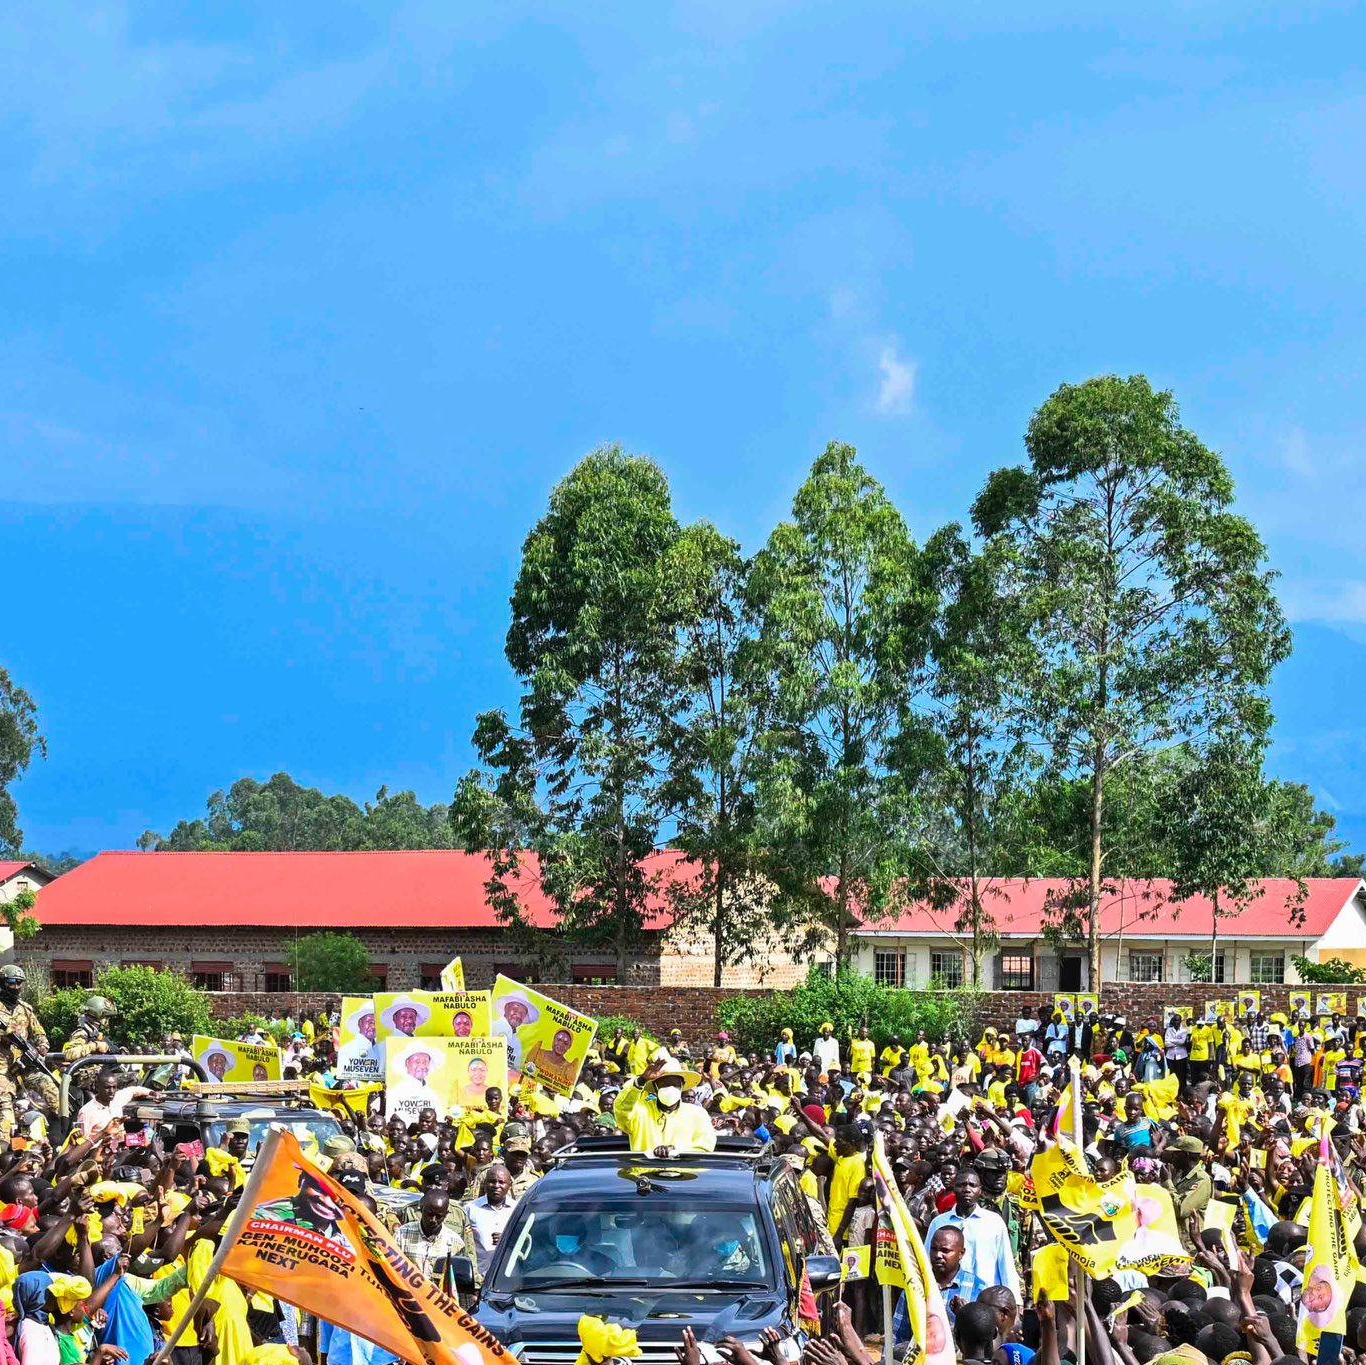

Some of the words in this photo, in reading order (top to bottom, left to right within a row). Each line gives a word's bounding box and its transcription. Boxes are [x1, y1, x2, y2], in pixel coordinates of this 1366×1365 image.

[545, 1004, 573, 1021] MAFABI
[571, 1018, 593, 1032] ASHA
[552, 1015, 582, 1034] NABULO
[237, 1046, 261, 1055] MAFABI
[262, 1050, 278, 1058] ASHA
[246, 1053, 270, 1063] NABULO
[343, 1065, 380, 1074] MUSEVEN
[1324, 1167, 1335, 1228] PROTECTING
[249, 1220, 323, 1246] CHAIRMAN
[325, 1242, 354, 1260] PLU
[1329, 1228, 1337, 1246] THE
[236, 1238, 350, 1280] KAINERUGABA
[240, 1231, 280, 1244] GEN.
[282, 1236, 356, 1273] MUHOOZI
[255, 1249, 301, 1272] NEXT
[1332, 1246, 1341, 1281] GAINS
[422, 1281, 460, 1317] THE
[457, 1309, 507, 1357] GAINS
